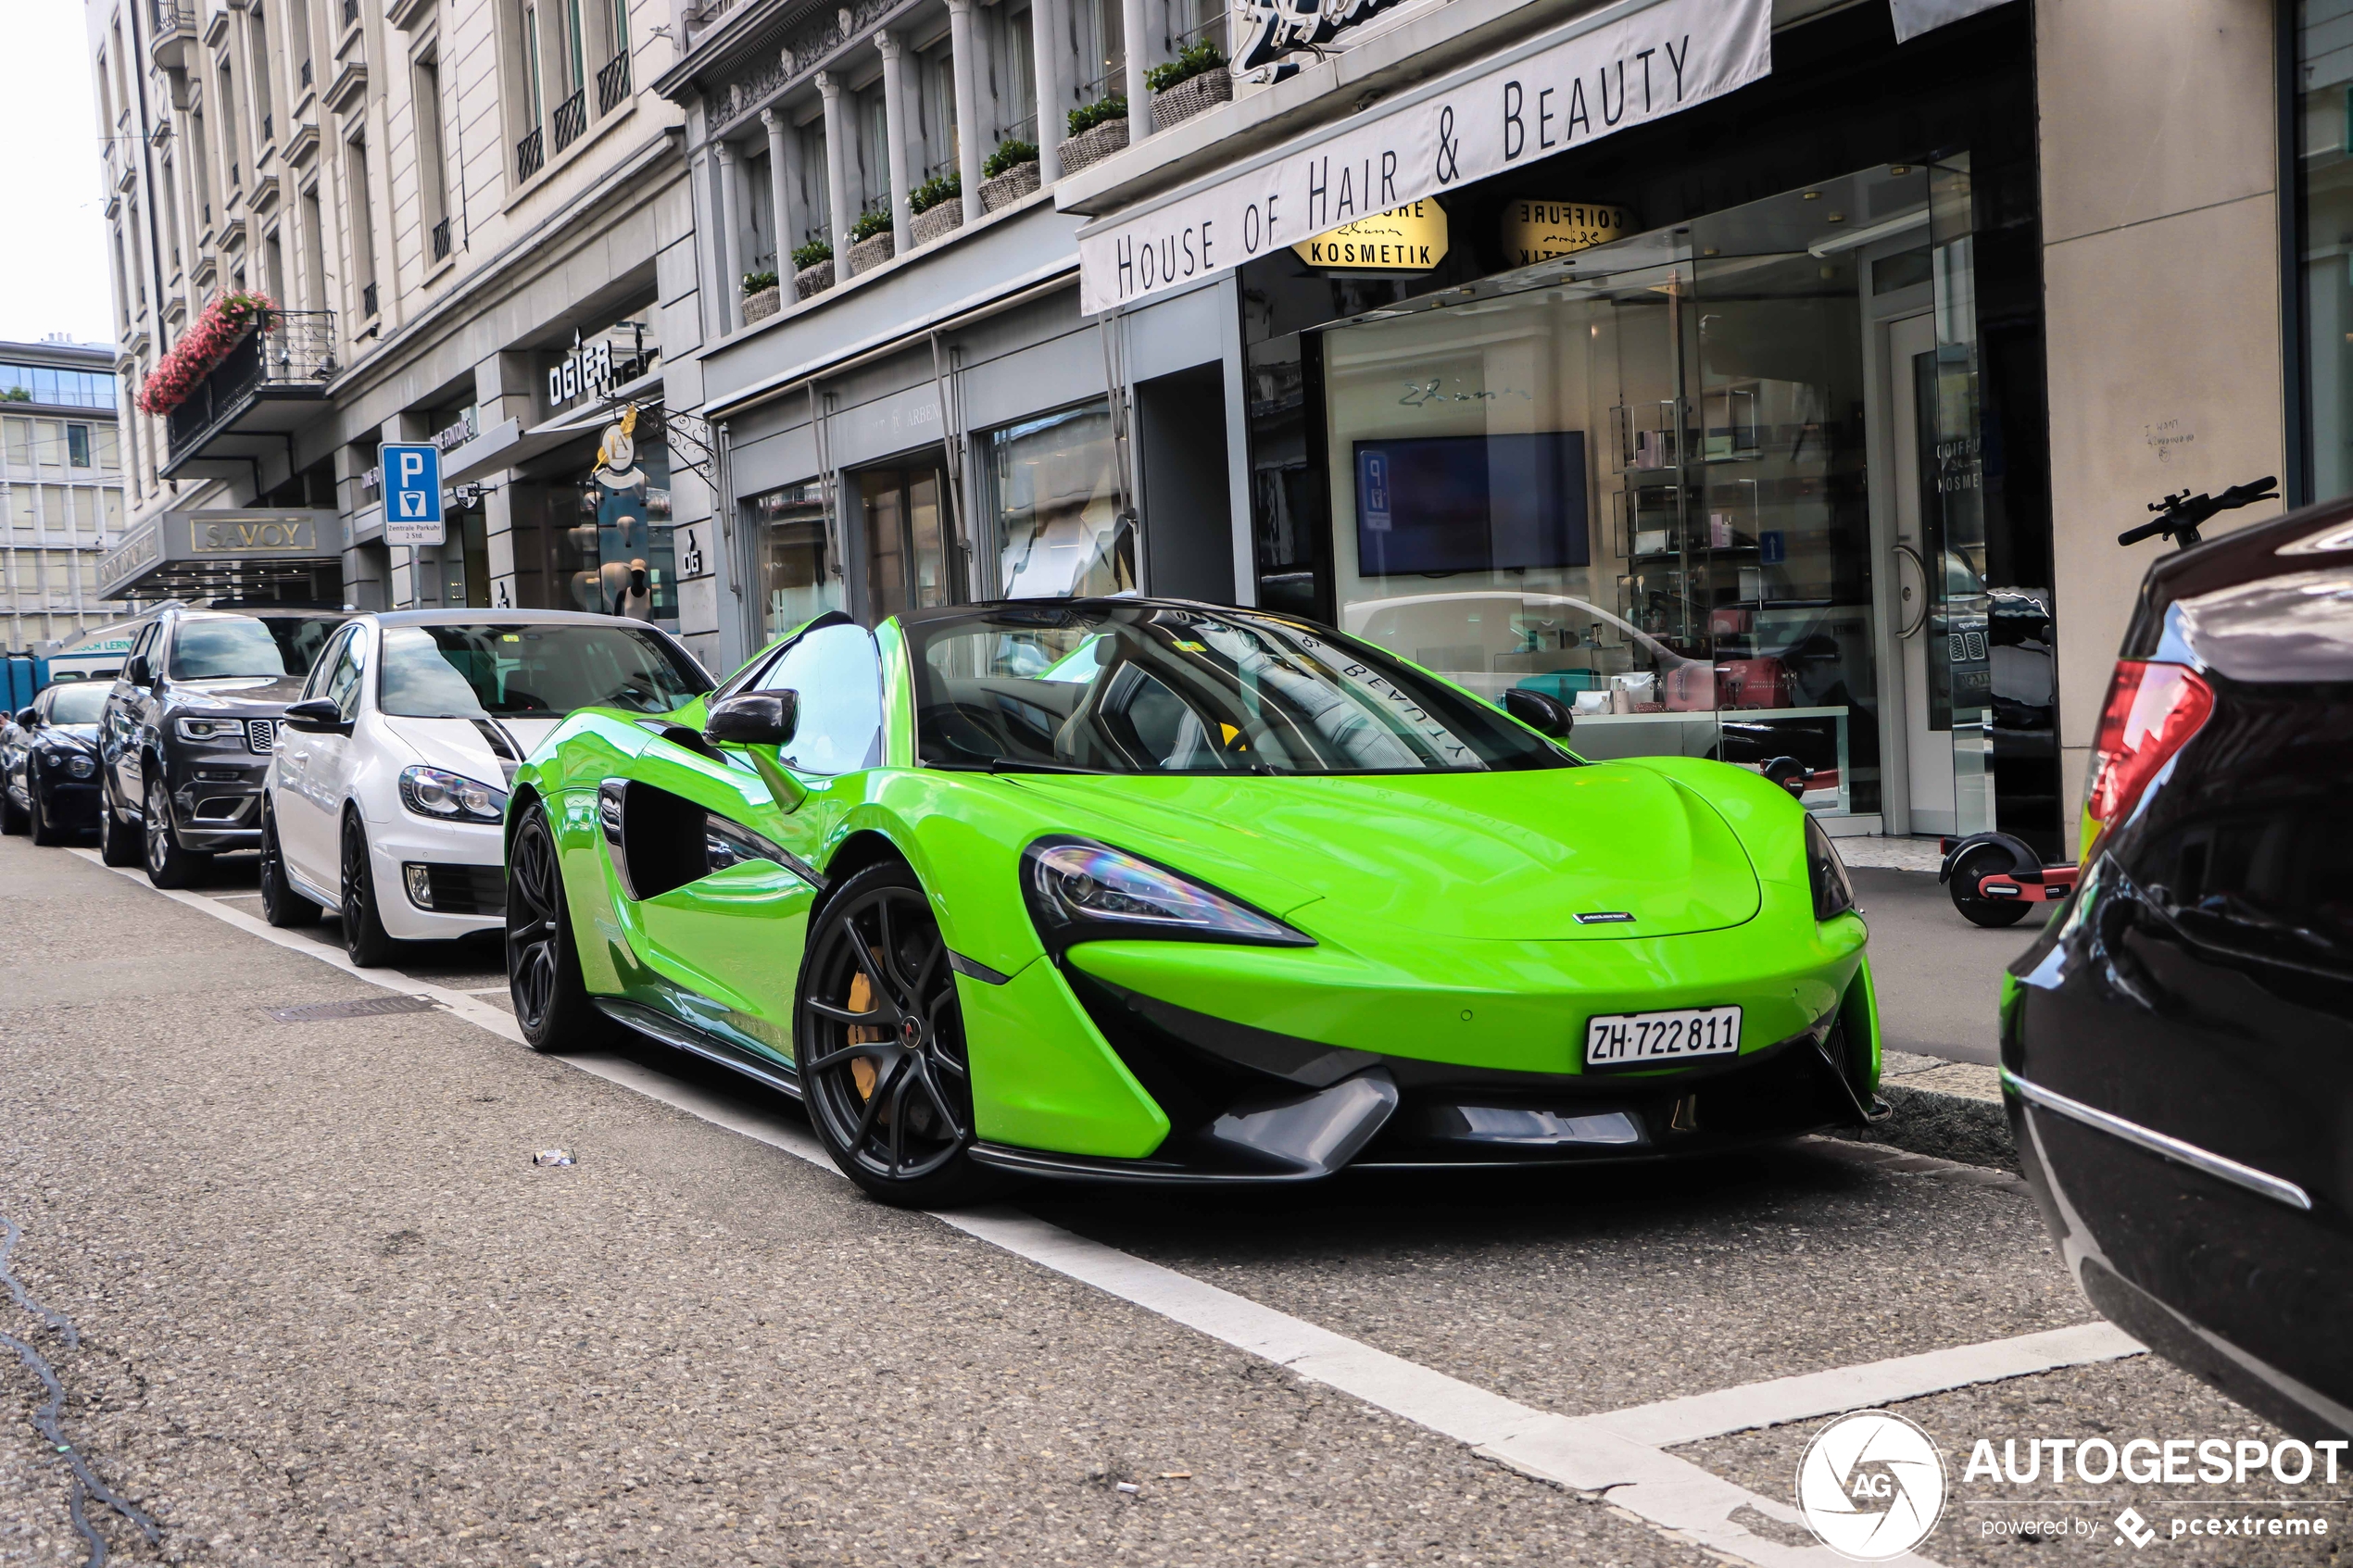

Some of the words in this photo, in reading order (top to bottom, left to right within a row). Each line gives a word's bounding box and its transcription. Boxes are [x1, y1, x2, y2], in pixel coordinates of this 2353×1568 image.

[1436, 105, 1460, 186] &
[1311, 243, 1431, 264] KOSMETIK
[548, 329, 612, 408] OGIER
[400, 452, 423, 488] P
[206, 523, 300, 547] SAVOY
